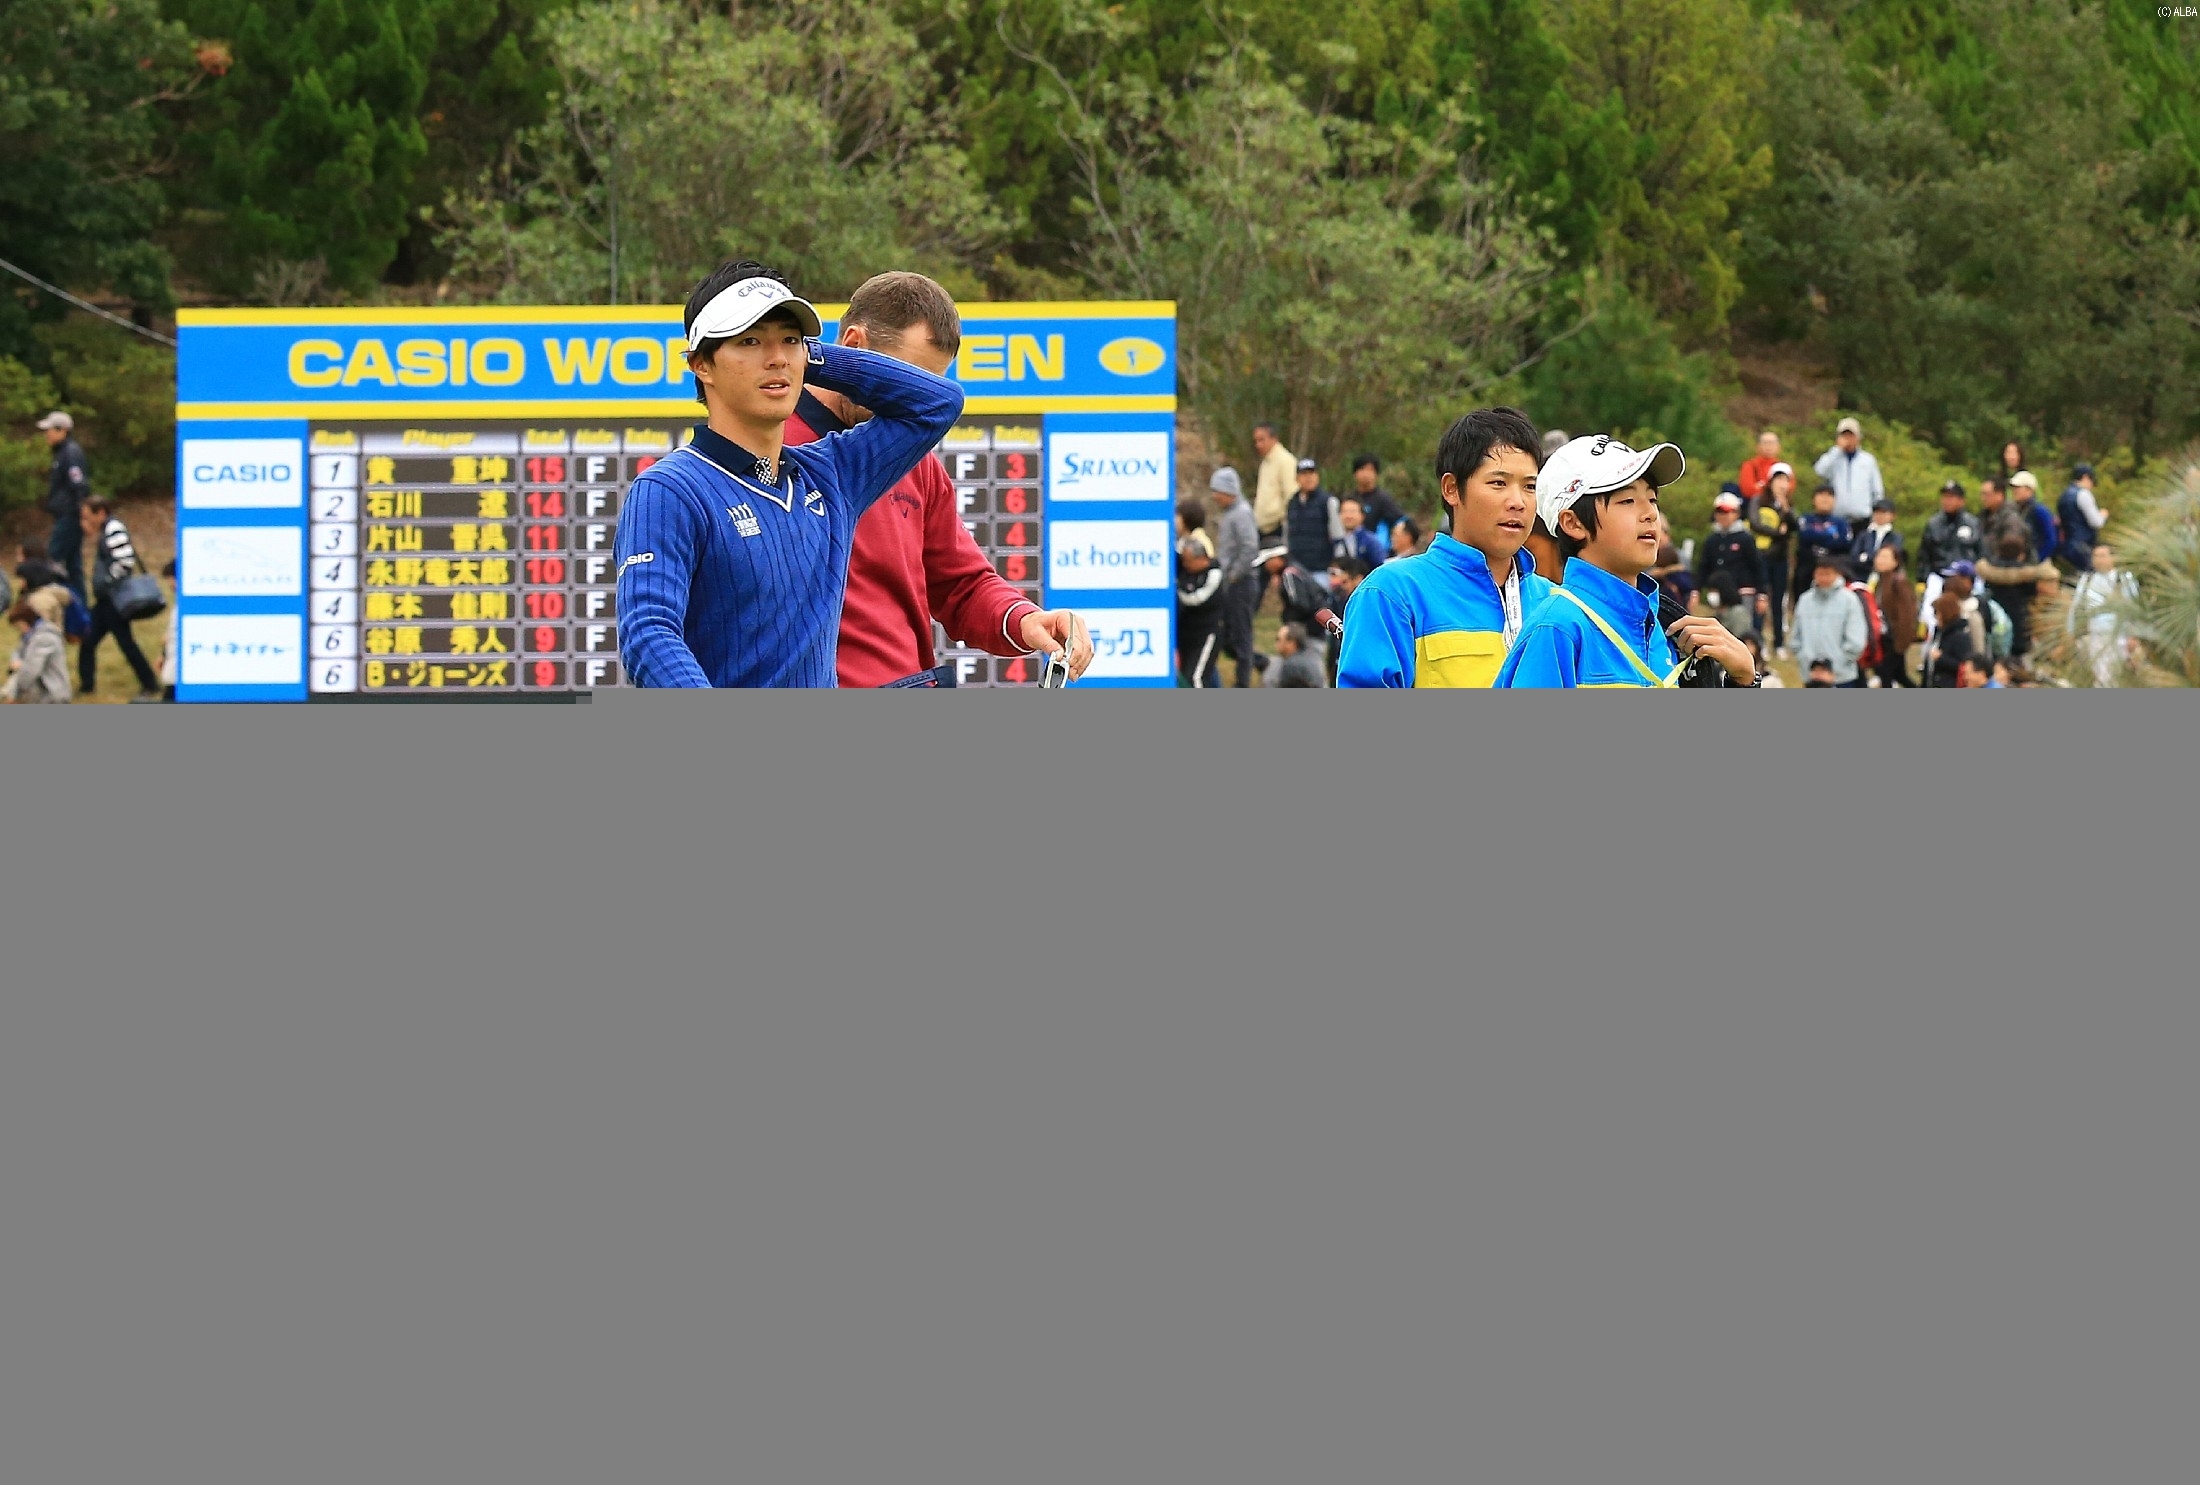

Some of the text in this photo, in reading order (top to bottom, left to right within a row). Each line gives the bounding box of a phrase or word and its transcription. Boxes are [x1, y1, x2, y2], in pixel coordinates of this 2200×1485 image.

[288, 338, 526, 388] CASIO
[957, 334, 1065, 382] EN
[193, 464, 292, 483] CASIO
[331, 460, 341, 483] 1
[526, 455, 566, 484] 15
[585, 455, 607, 484] F
[956, 452, 1027, 481] F 3
[1057, 451, 1160, 485] SRIXON
[324, 495, 344, 518] 2
[367, 489, 423, 519] 石川
[526, 489, 565, 519] 14
[585, 489, 607, 518] F
[956, 486, 1027, 515] F 6
[325, 529, 343, 551] 3
[367, 522, 424, 553] 片山
[526, 523, 560, 553] 11
[585, 522, 607, 552] F
[1005, 520, 1027, 549] 4
[1006, 553, 1027, 581] 5
[1056, 543, 1163, 567] at home
[324, 561, 342, 583] 4
[526, 556, 565, 585] 10
[585, 556, 607, 585] F
[324, 596, 342, 617] 4
[526, 590, 566, 620] 10
[585, 590, 607, 620] F
[325, 629, 343, 651] 6
[534, 624, 557, 654] 9
[585, 624, 607, 653] F
[1087, 629, 1155, 657] テックス
[325, 658, 607, 689] 6 B・ジョーンズ 9 F
[956, 656, 1028, 685] F 4
